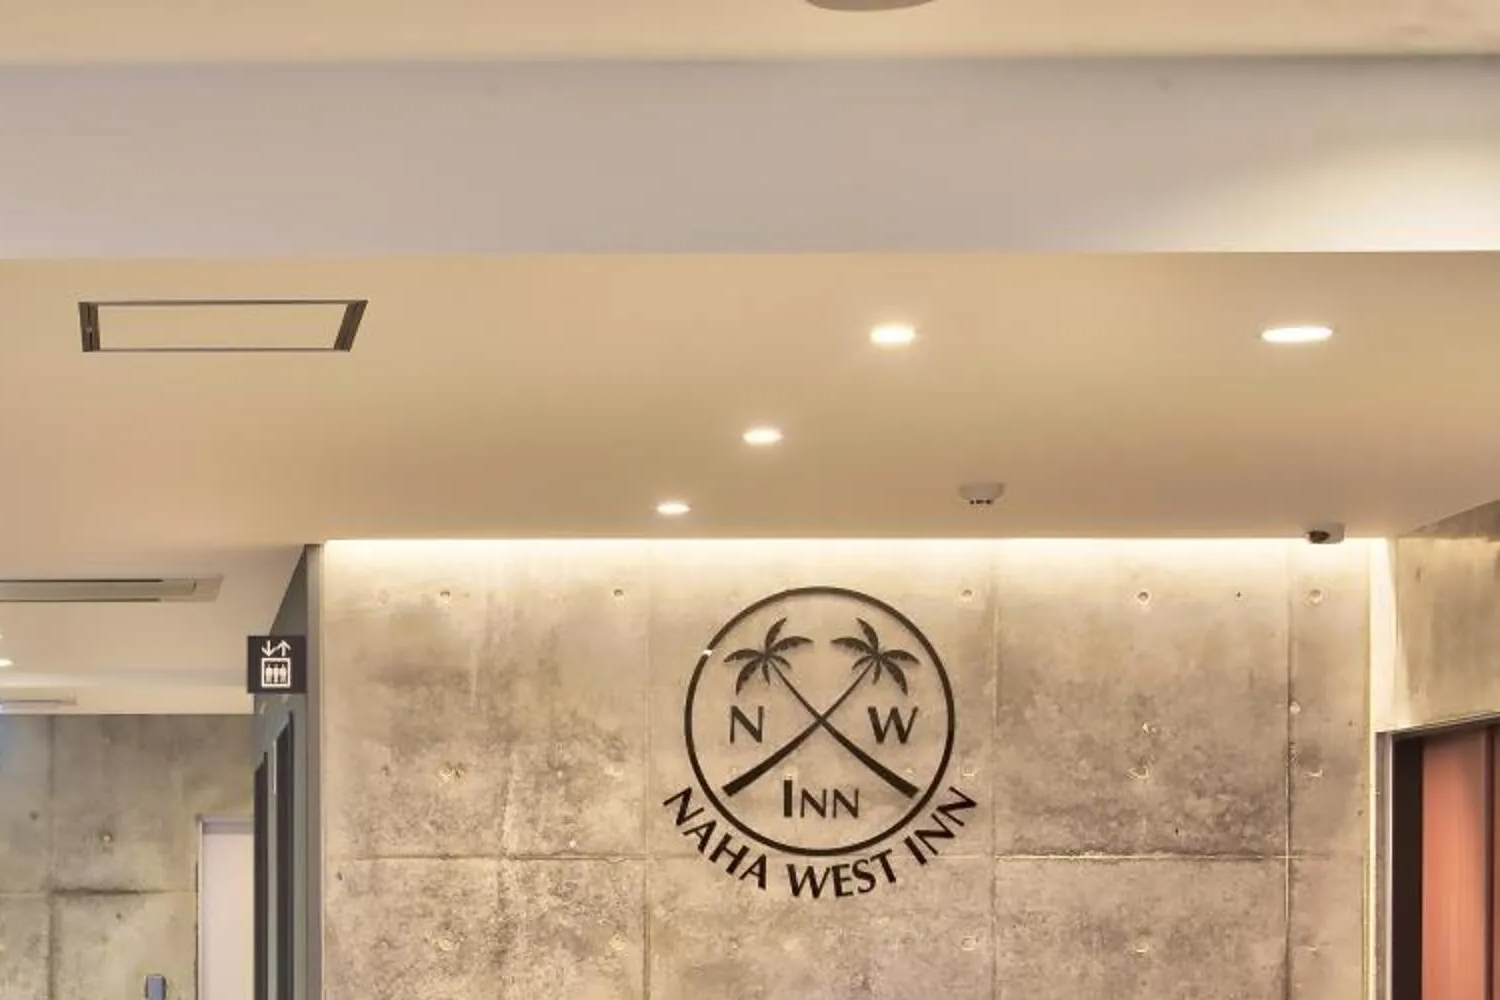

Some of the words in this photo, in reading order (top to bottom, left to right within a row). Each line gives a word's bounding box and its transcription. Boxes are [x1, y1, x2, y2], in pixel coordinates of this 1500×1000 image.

[729, 705, 765, 744] N
[867, 705, 919, 745] W
[662, 786, 768, 891] NAHA
[786, 848, 898, 900] WEST
[903, 785, 978, 866] INN
